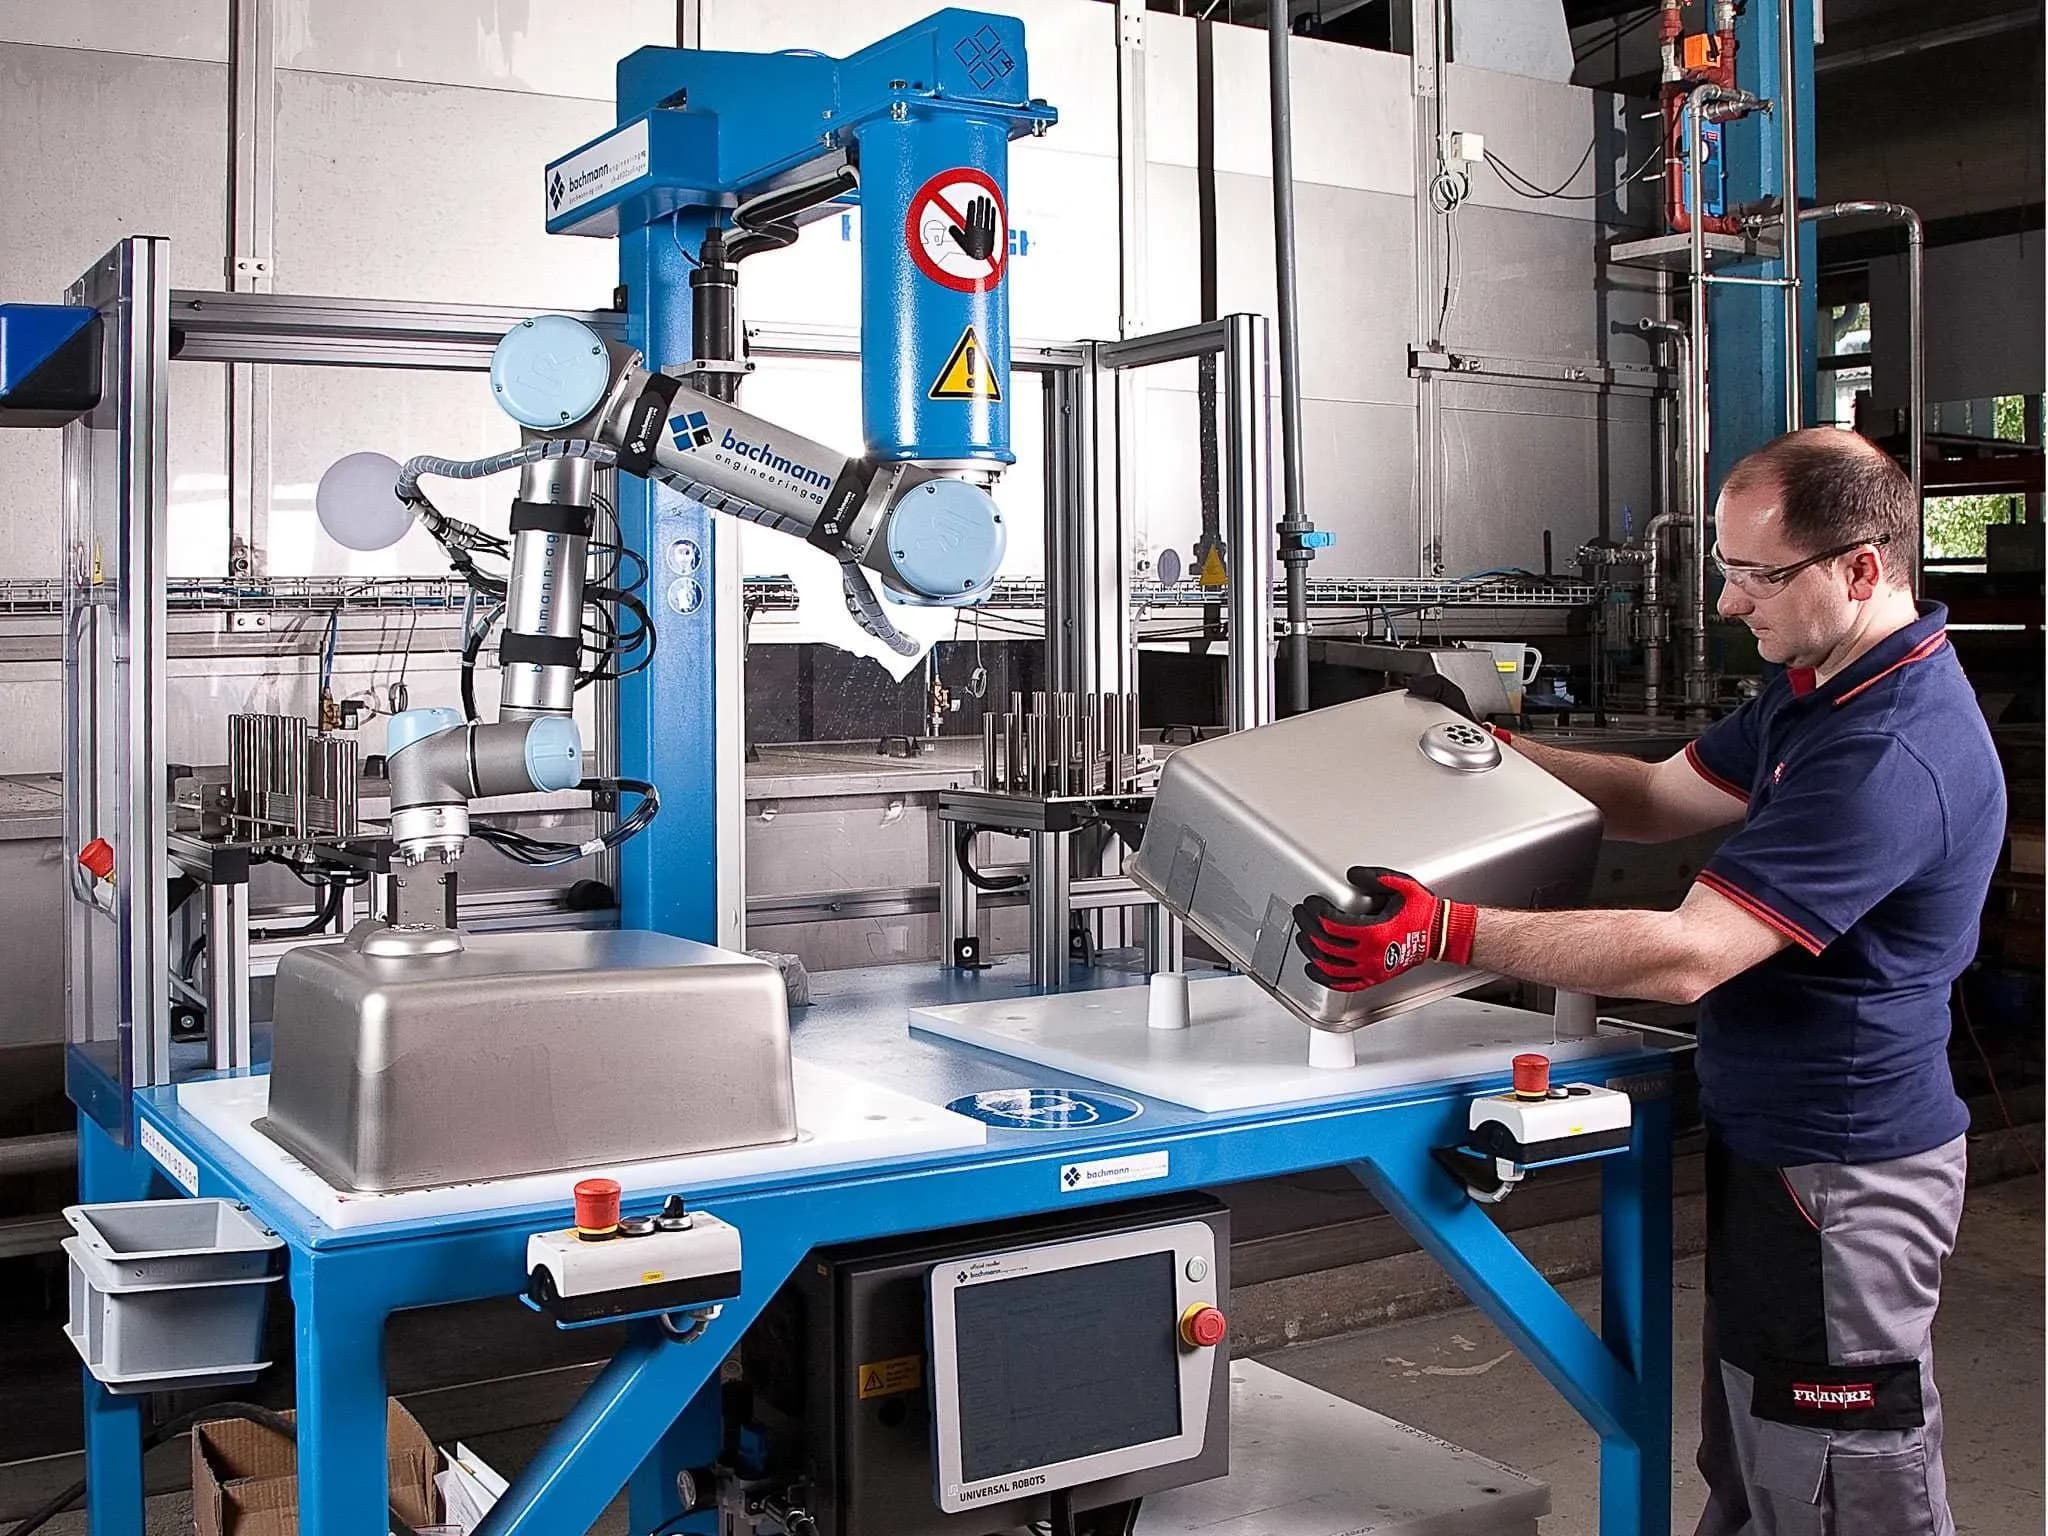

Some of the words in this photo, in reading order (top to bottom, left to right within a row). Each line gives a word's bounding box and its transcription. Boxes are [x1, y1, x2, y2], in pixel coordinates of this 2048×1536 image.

[569, 163, 609, 192] bachmann
[720, 428, 833, 490] bachmann
[1086, 1166, 1130, 1179] bachmann
[1793, 1389, 1871, 1404] FRANKE
[959, 1483, 1010, 1502] UNIVERSAL
[1012, 1474, 1046, 1490] ROBOTS
